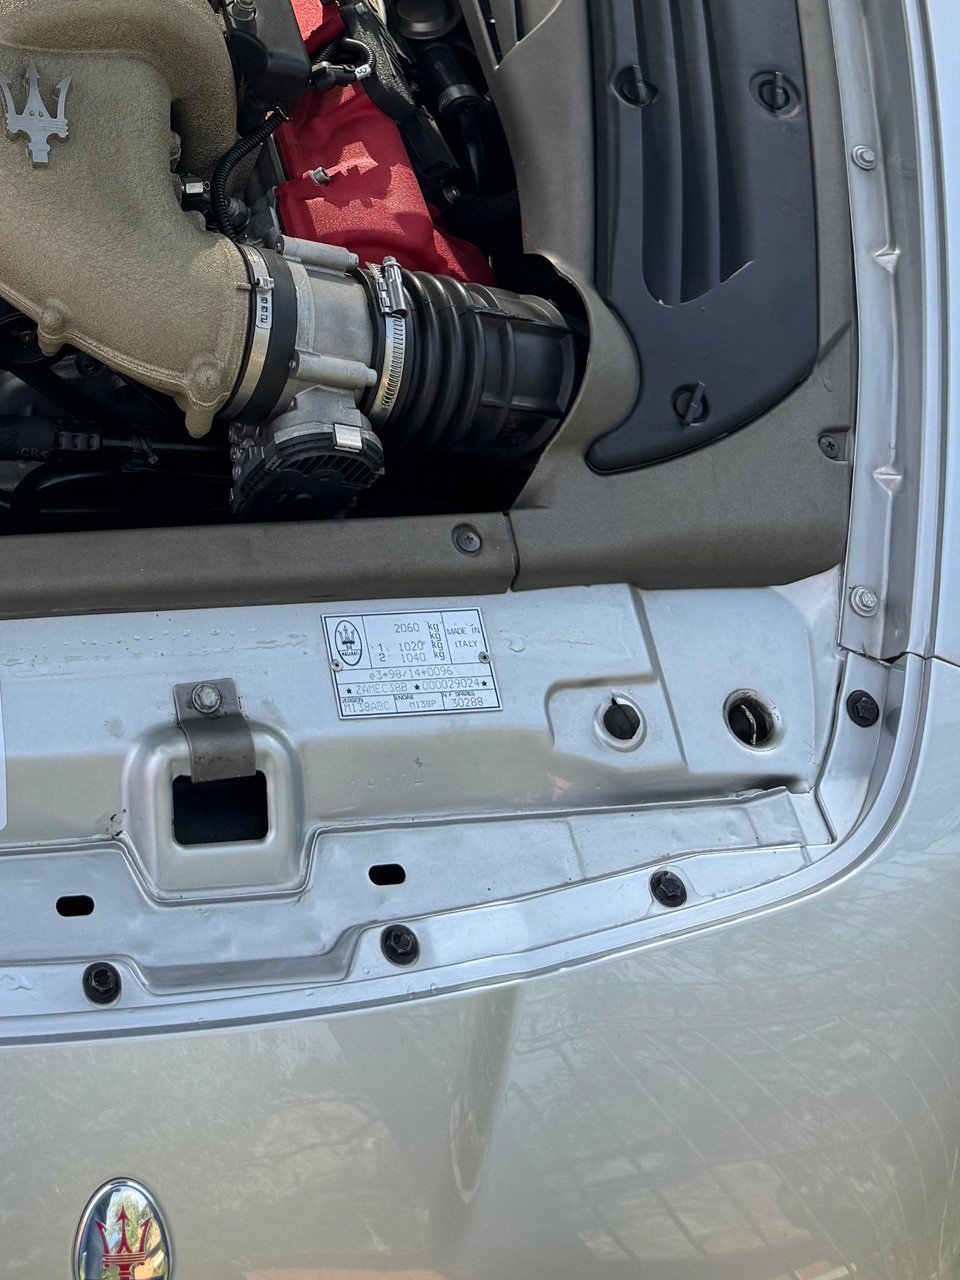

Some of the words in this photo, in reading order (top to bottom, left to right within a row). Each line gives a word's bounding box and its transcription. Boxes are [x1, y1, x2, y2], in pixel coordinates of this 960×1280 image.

[394, 622, 420, 633] 2060
[427, 621, 439, 632] kg
[446, 627, 467, 635] MADE
[471, 626, 480, 634] IN
[429, 631, 441, 641] kg
[377, 643, 383, 652] 1
[399, 641, 424, 652] 1020
[431, 640, 444, 651] kg
[454, 640, 478, 648] ITALY
[378, 652, 386, 662] 2
[401, 652, 426, 663] 1040
[433, 649, 445, 660] kg
[451, 696, 484, 708] 30288
